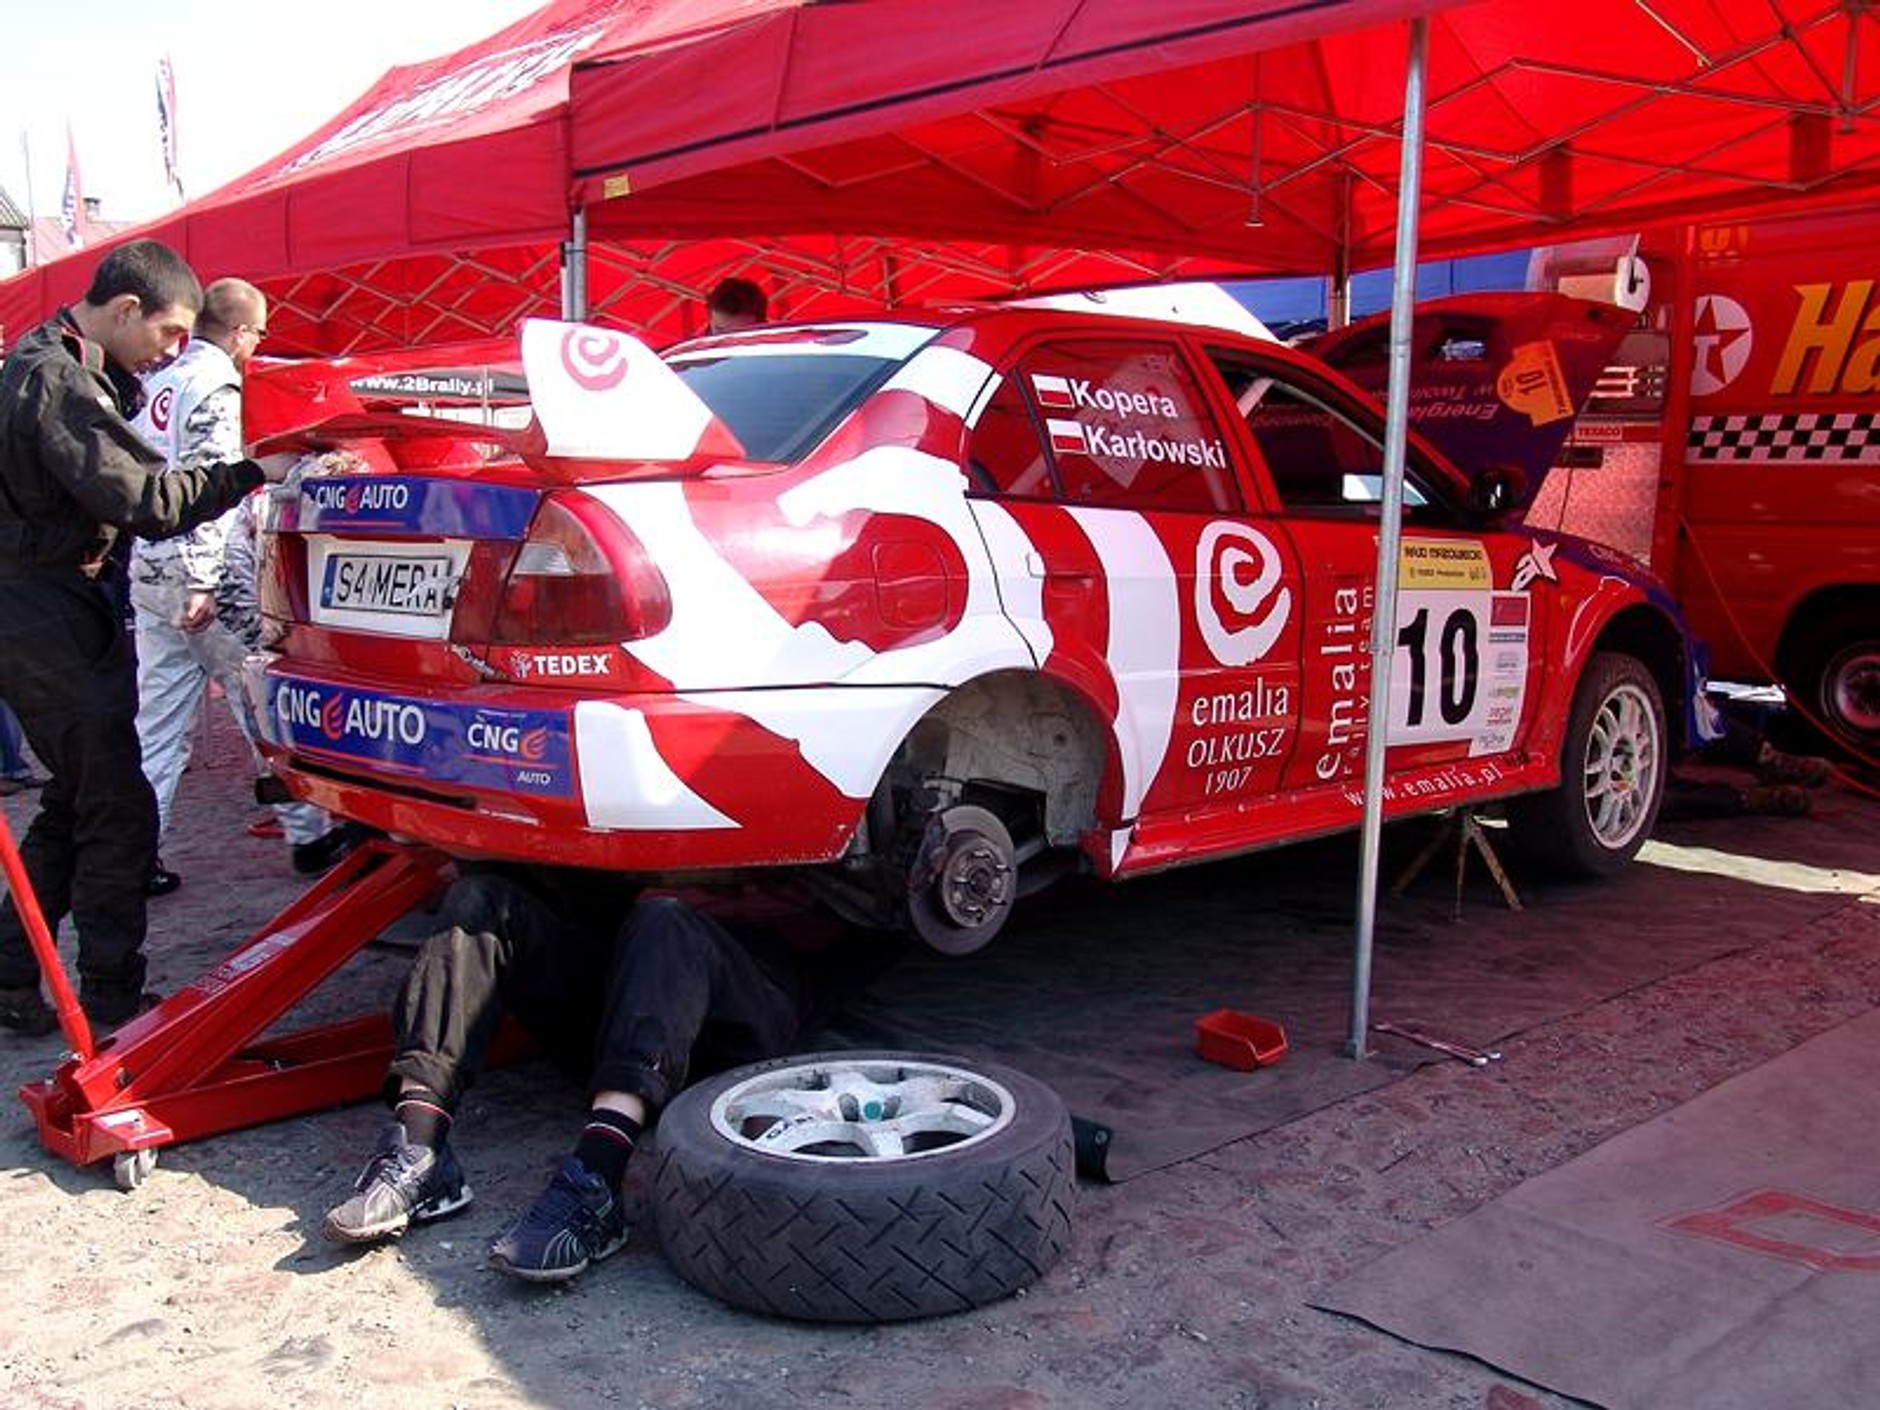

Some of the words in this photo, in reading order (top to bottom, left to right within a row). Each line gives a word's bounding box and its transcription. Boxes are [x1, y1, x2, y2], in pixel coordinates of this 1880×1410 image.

[1070, 378, 1179, 419] Kopera
[1084, 424, 1227, 468] Karłowski
[359, 484, 408, 509] AUTO
[337, 561, 368, 602] S4
[534, 652, 611, 675] TEDEX
[1315, 587, 1358, 780] emalia
[1397, 608, 1479, 727] 10
[345, 698, 425, 745] AUTO
[1191, 677, 1289, 727] emalia
[1187, 728, 1285, 768] OLKUSZ
[517, 770, 551, 785] AUTO
[1204, 766, 1252, 796] 1907
[1343, 763, 1504, 808] ww.emalia.pl
